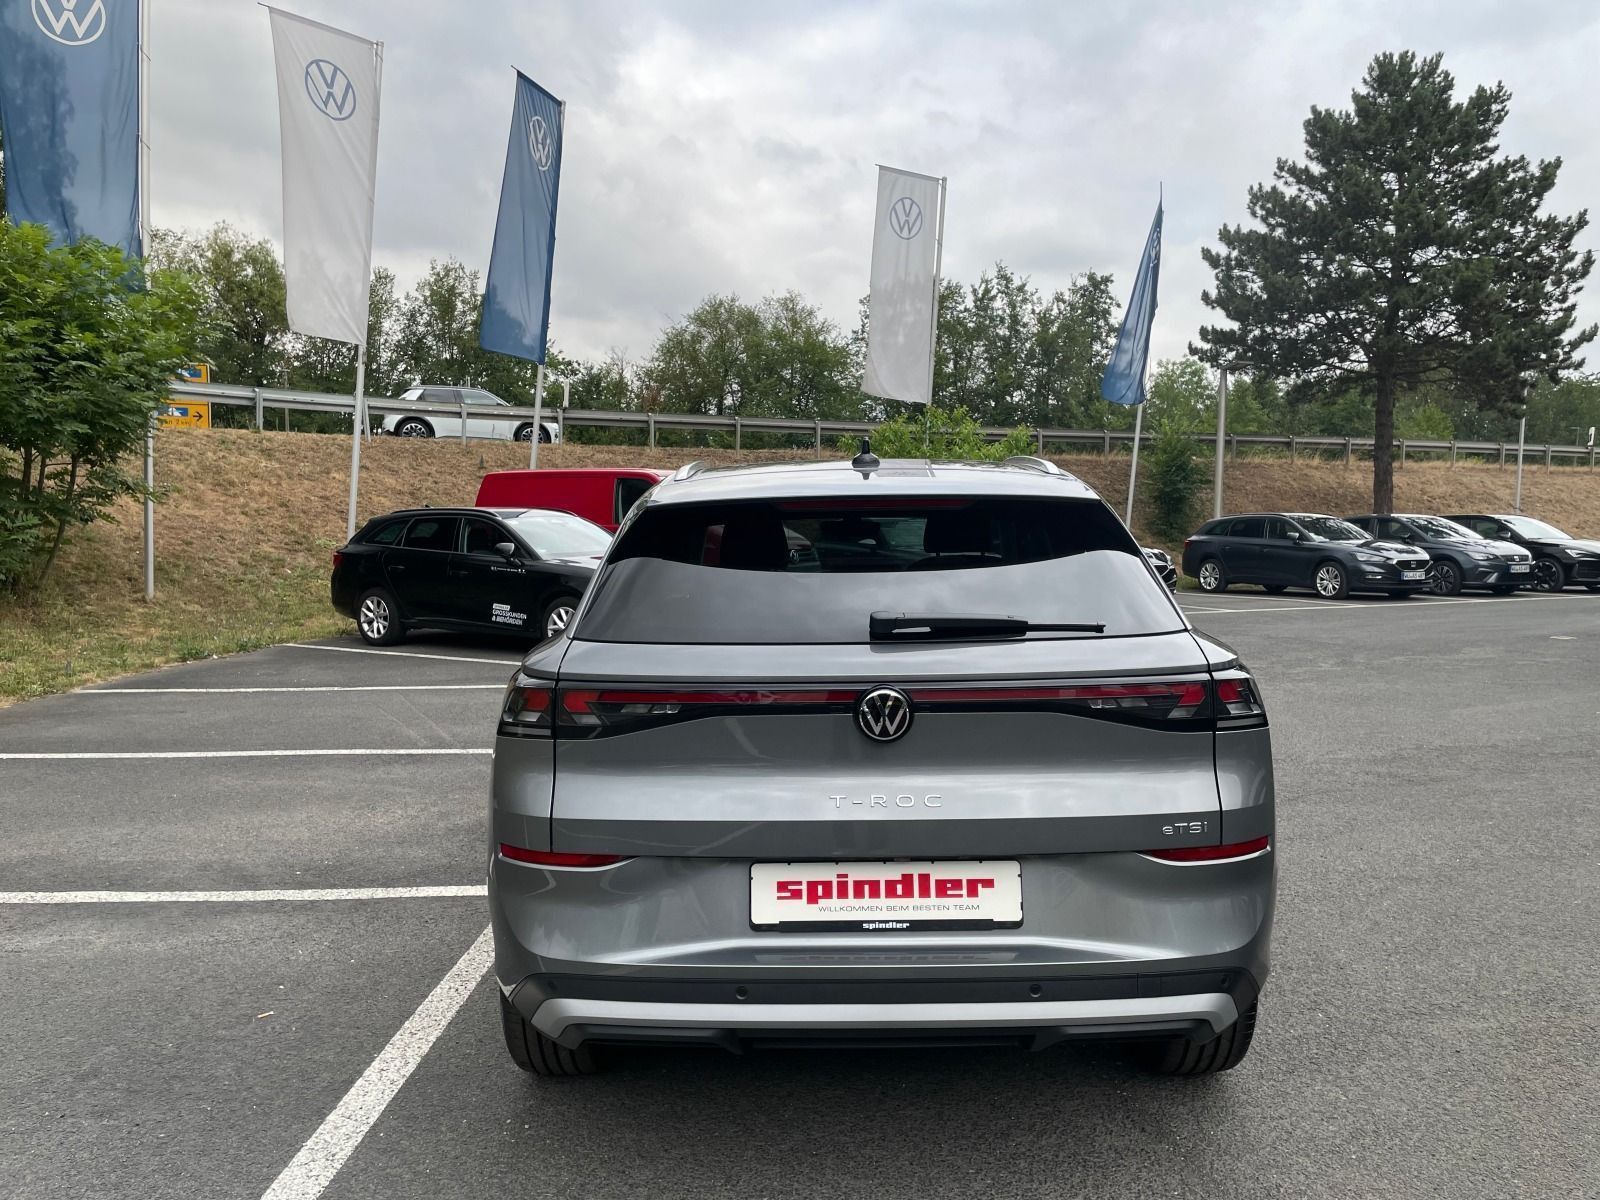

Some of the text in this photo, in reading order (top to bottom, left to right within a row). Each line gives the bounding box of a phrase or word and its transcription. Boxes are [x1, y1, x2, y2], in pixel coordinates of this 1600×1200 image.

[35, 0, 102, 39] W
[306, 61, 352, 117] VW
[891, 198, 922, 237] VW
[861, 692, 907, 737] VW
[829, 794, 943, 808] T-ROC
[1162, 821, 1208, 835] eTSi
[776, 873, 995, 904] spindler
[862, 921, 910, 930] spindler
